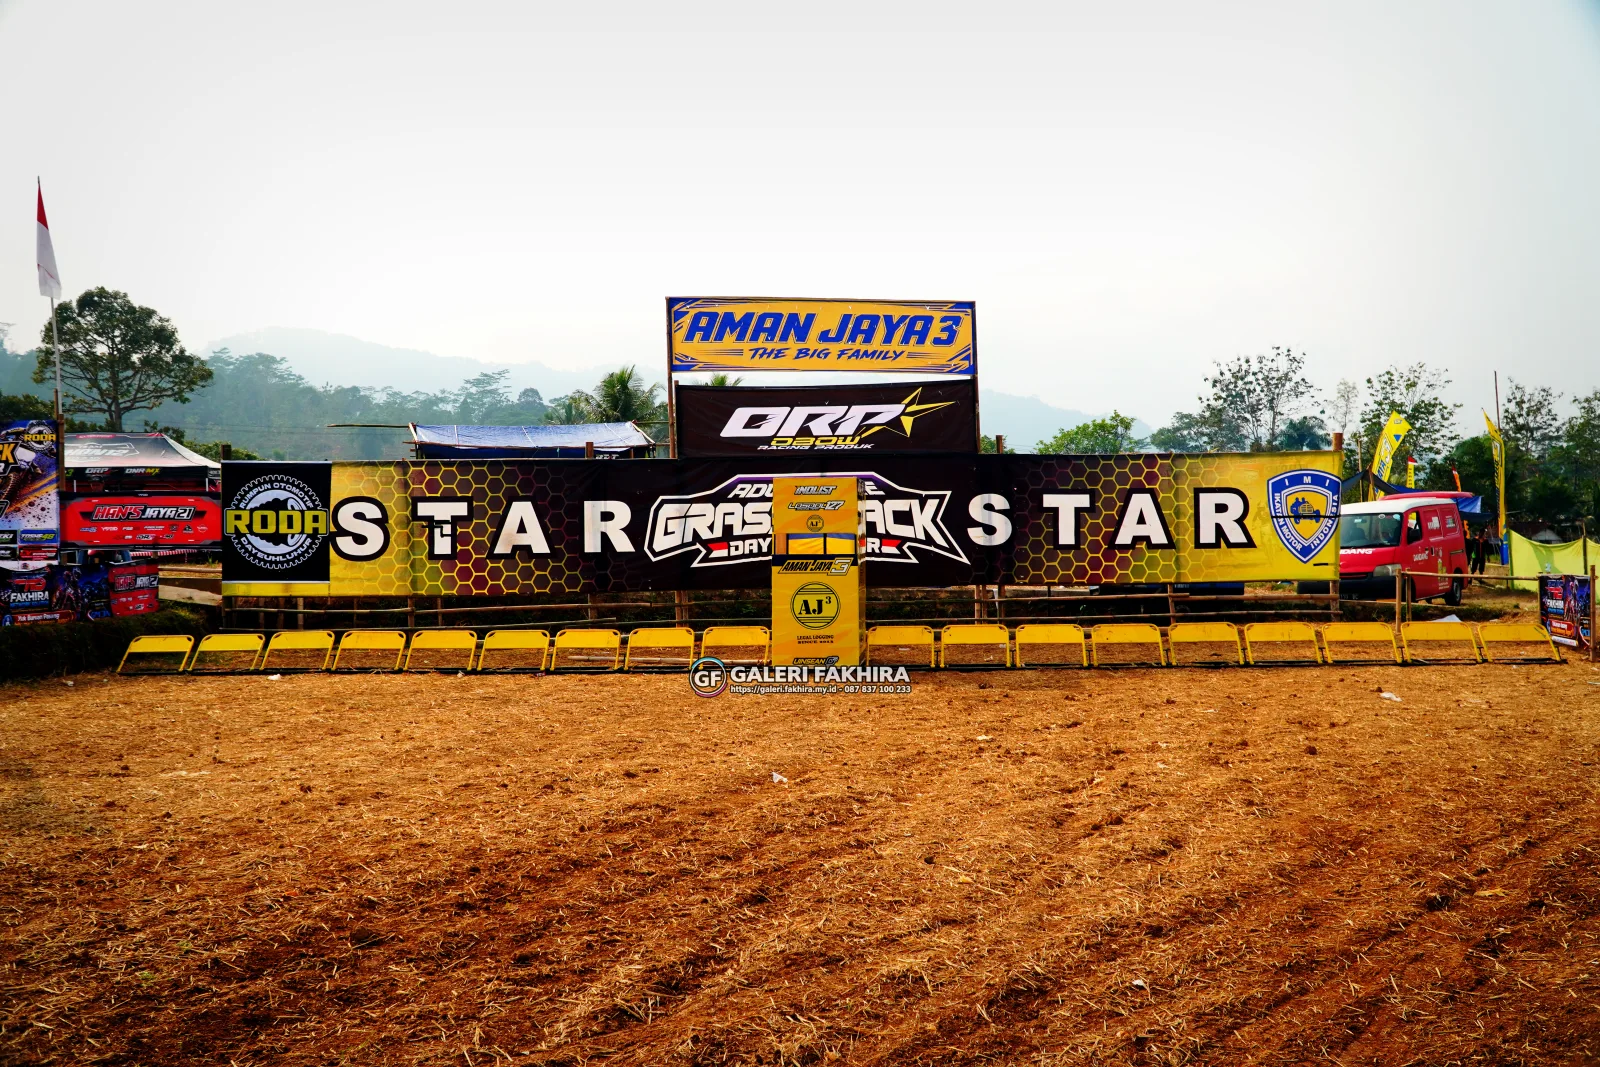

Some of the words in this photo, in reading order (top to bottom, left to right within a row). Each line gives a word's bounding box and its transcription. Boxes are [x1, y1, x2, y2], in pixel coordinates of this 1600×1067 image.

[683, 311, 815, 344] AMAN
[748, 347, 790, 361] THE
[793, 348, 832, 361] BIG
[836, 348, 906, 362] FAMILY
[24, 433, 57, 442] RODA
[239, 482, 272, 509] RUMPUN
[273, 482, 314, 509] OTOMOTIF
[226, 510, 327, 534] RODA
[240, 536, 313, 562] DAYEUHLUHUR
[1281, 526, 1303, 552] MOTOR
[782, 560, 810, 571] AMAN
[10, 591, 50, 602] FAKHIRA
